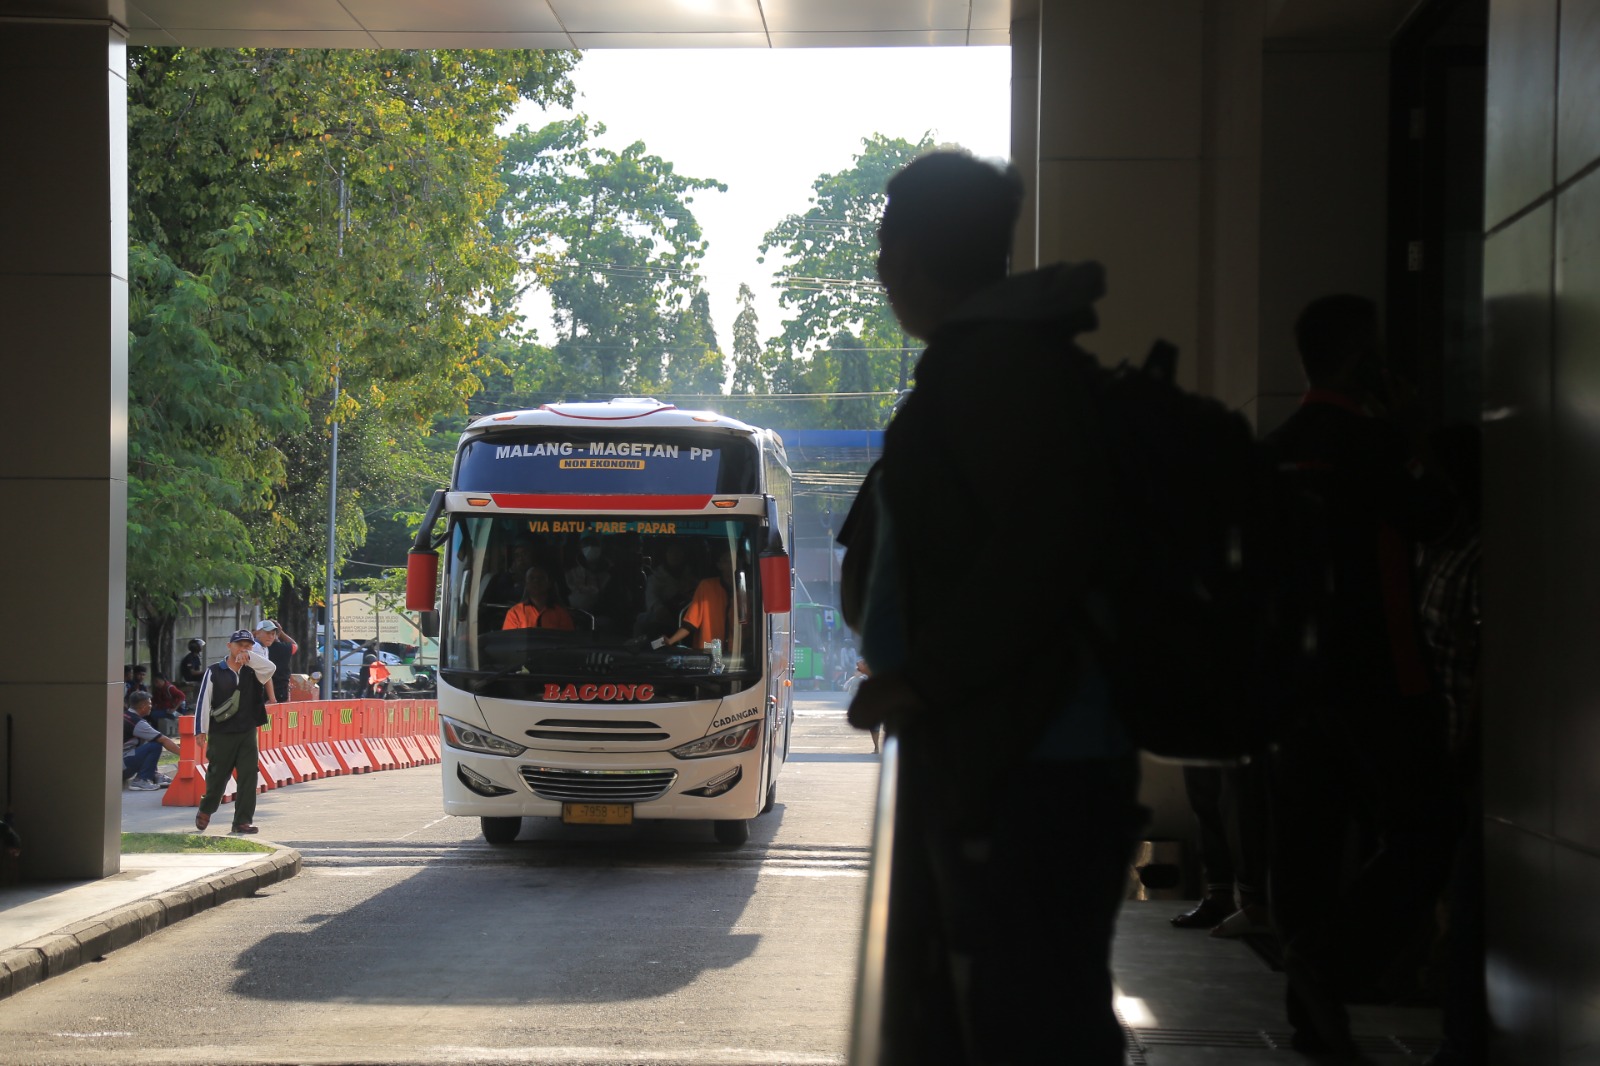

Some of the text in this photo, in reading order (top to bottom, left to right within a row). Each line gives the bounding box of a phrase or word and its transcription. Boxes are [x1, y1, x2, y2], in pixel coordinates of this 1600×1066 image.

[495, 442, 572, 460] MALANG
[589, 442, 679, 459] MAGETAN
[690, 447, 713, 462] PP
[564, 460, 641, 469] NON EKONOMI
[529, 521, 550, 533] VIA
[553, 521, 585, 533] BATU
[595, 522, 627, 533] PARE
[637, 522, 676, 534] PAPAR
[543, 683, 655, 701] BAGONG
[713, 706, 759, 728] CADANGAN
